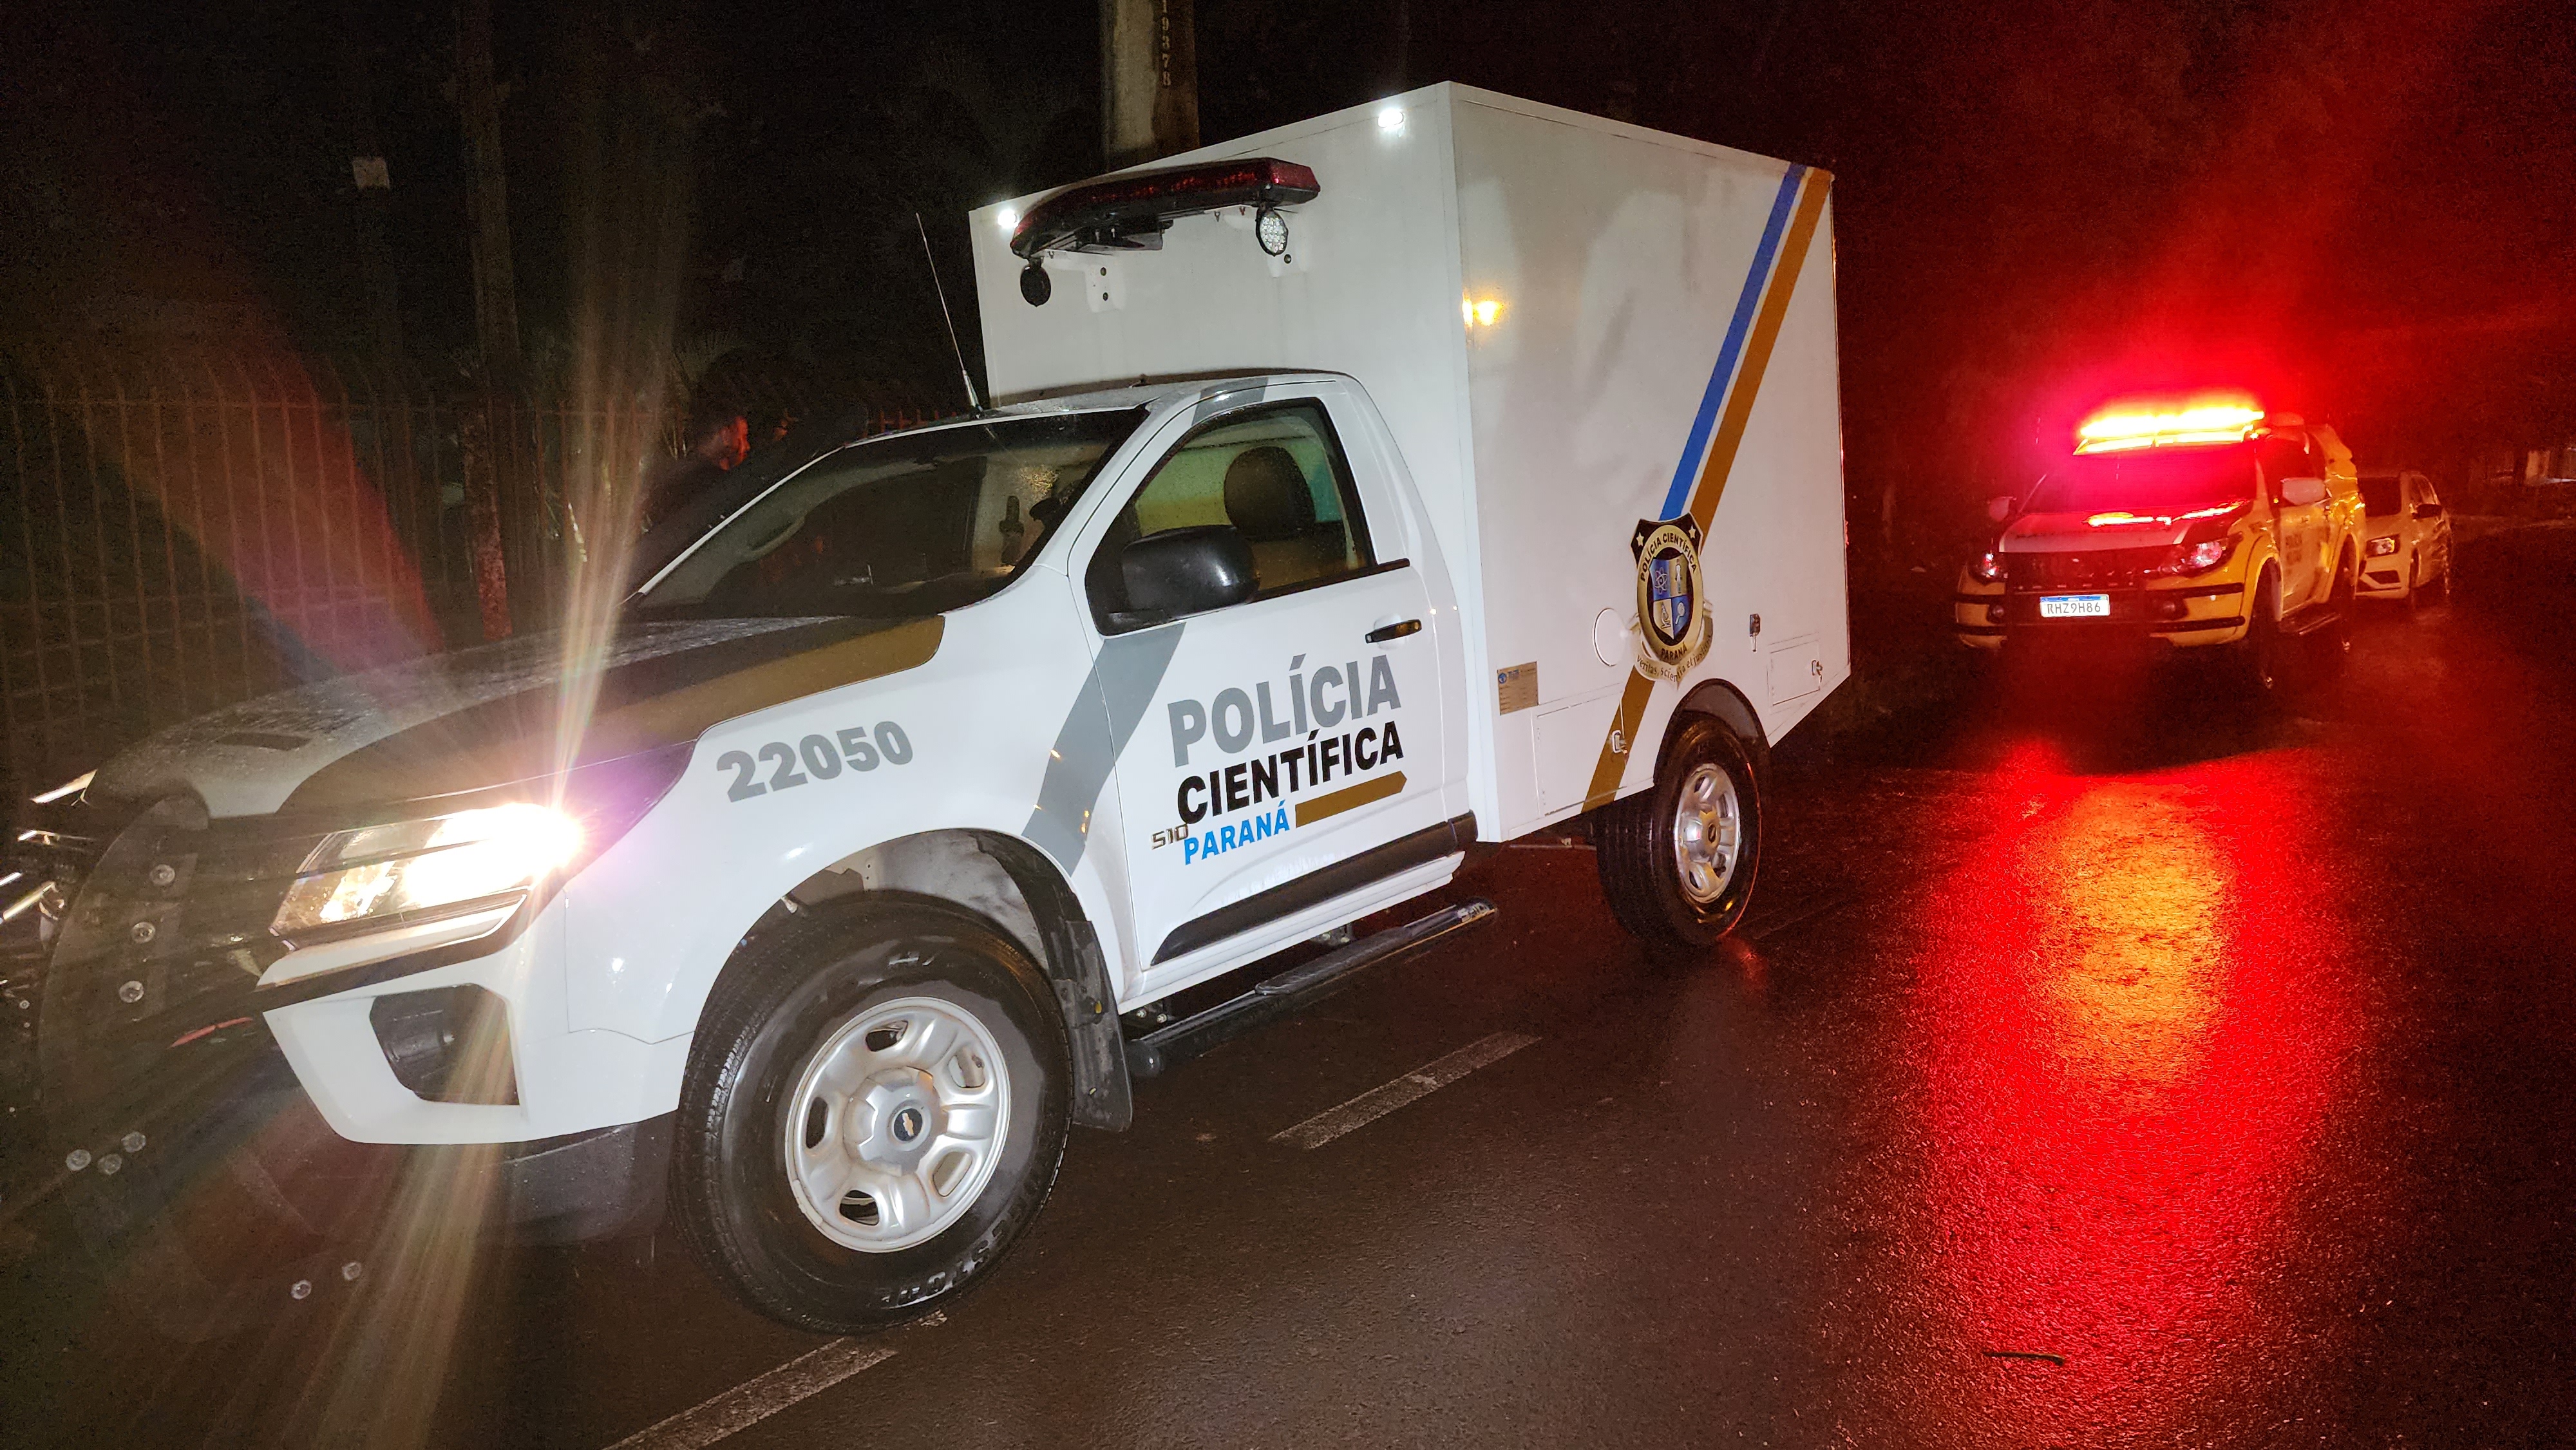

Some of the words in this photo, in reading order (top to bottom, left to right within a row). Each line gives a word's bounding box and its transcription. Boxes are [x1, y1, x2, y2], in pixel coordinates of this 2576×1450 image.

[1641, 537, 1662, 581] POLÍCIA
[1663, 533, 1697, 573] CIENTÍFICA
[2047, 602, 2101, 614] RHZ9H86
[1662, 641, 1687, 660] PARANÁ
[1167, 653, 1401, 767] POLÍCIA
[717, 720, 913, 802] 22050
[1177, 720, 1404, 824] CIENTÍFICA
[1151, 824, 1189, 850] S10
[1184, 800, 1290, 865] PARANÁ
